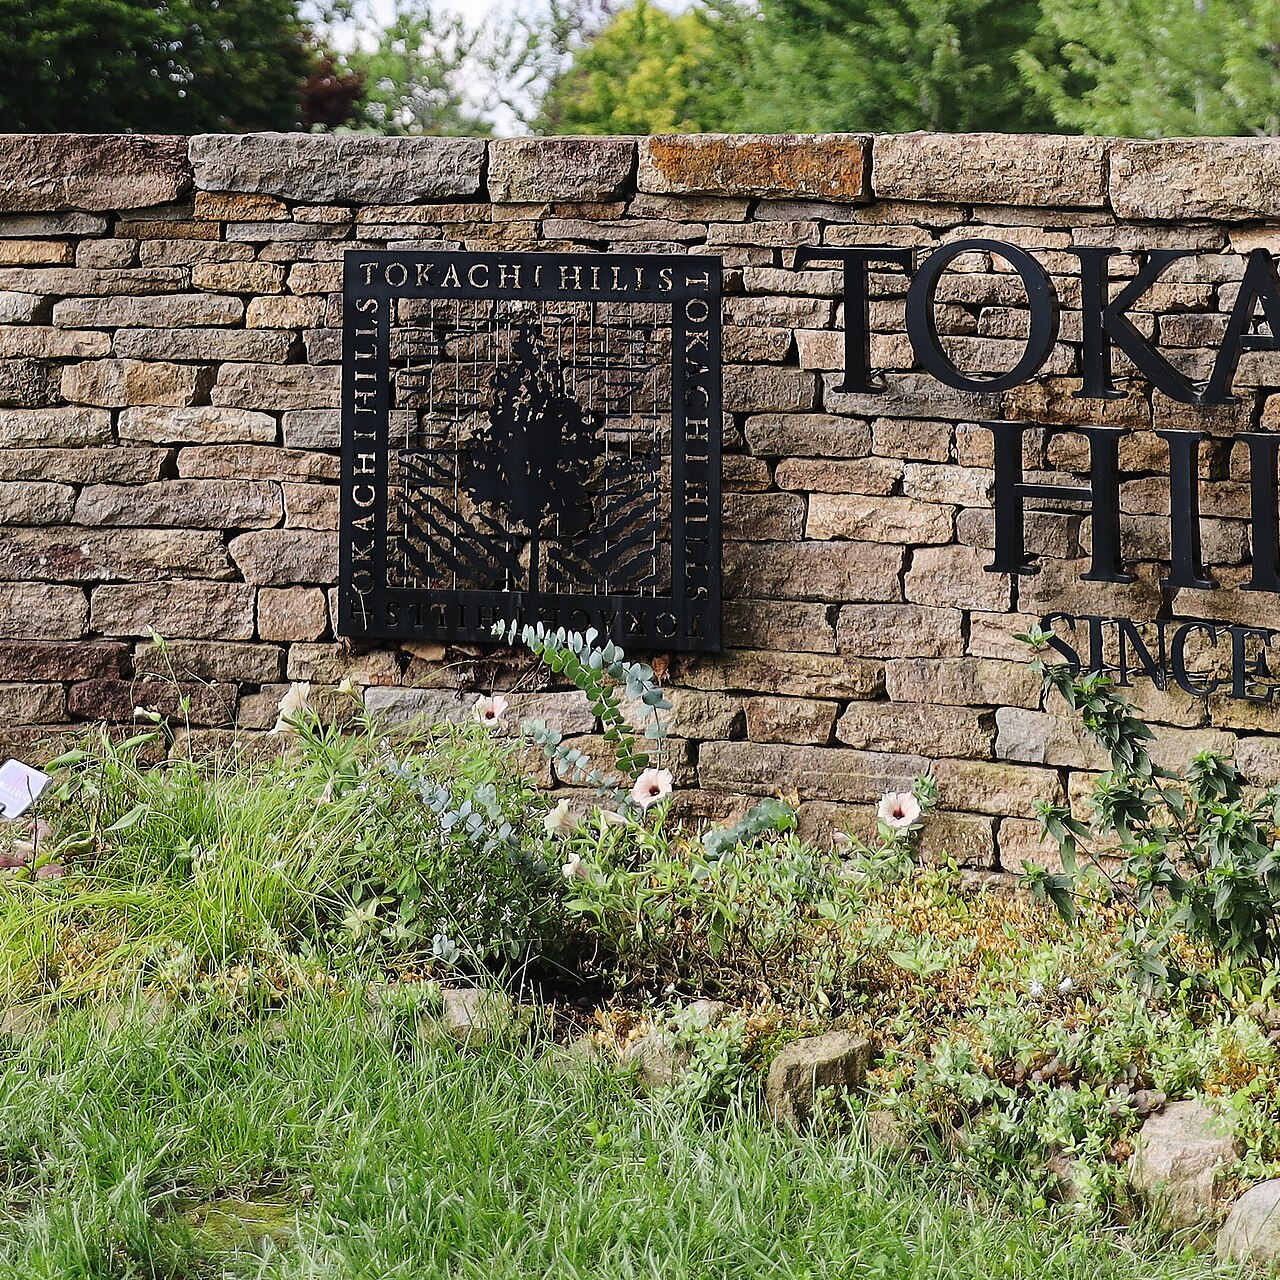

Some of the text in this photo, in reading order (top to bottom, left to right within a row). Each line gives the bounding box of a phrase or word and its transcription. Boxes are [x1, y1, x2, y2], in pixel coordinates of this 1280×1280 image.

[359, 261, 674, 293] TOKACHI HILLS
[683, 271, 710, 601] TOKACHI HILLS
[349, 297, 380, 622] TOKACHI HILLS
